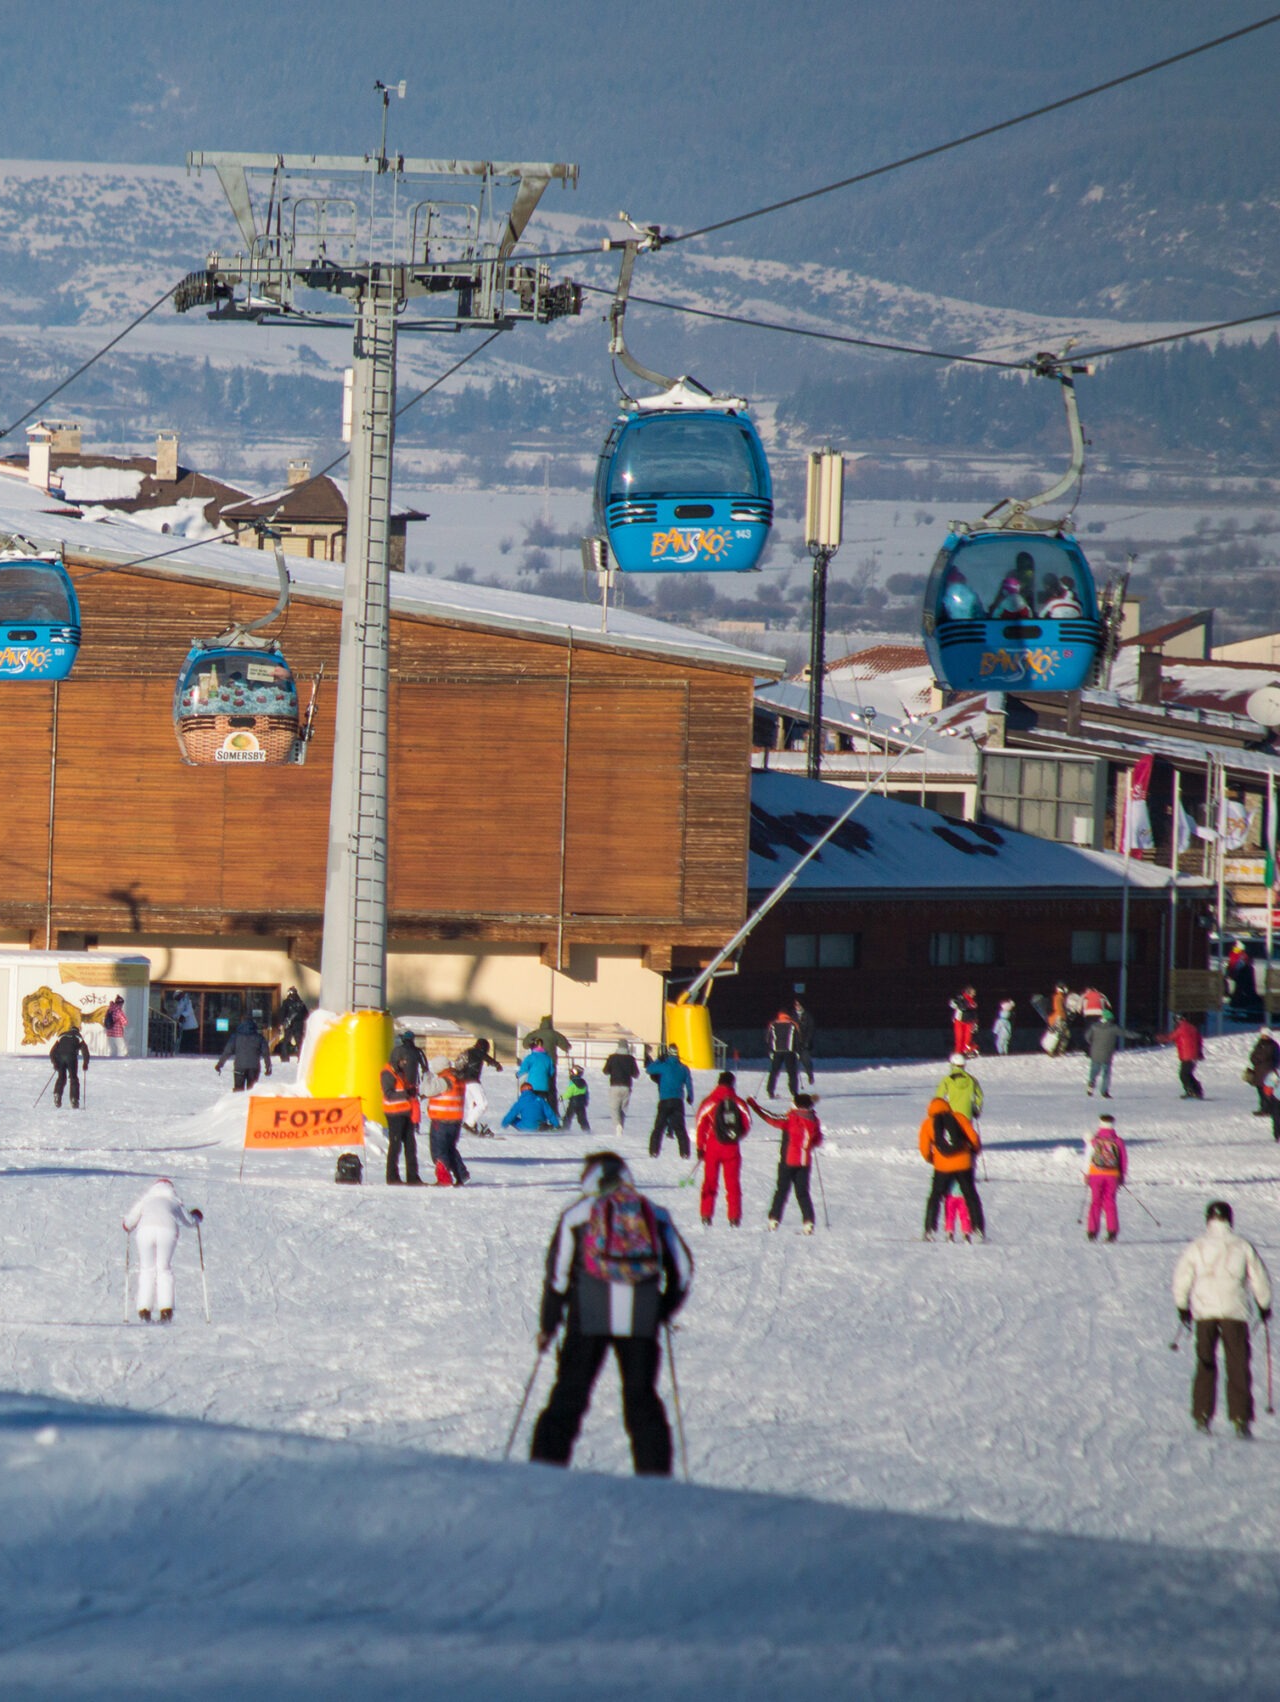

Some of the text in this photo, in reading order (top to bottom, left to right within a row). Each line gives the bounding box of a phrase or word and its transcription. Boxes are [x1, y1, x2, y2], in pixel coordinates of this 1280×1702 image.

[651, 527, 724, 561] BANSKO
[979, 647, 1051, 681] BANSKO
[216, 750, 264, 760] SOMERSBY
[273, 1108, 343, 1128] FOTO
[253, 1130, 309, 1140] GONDOLA
